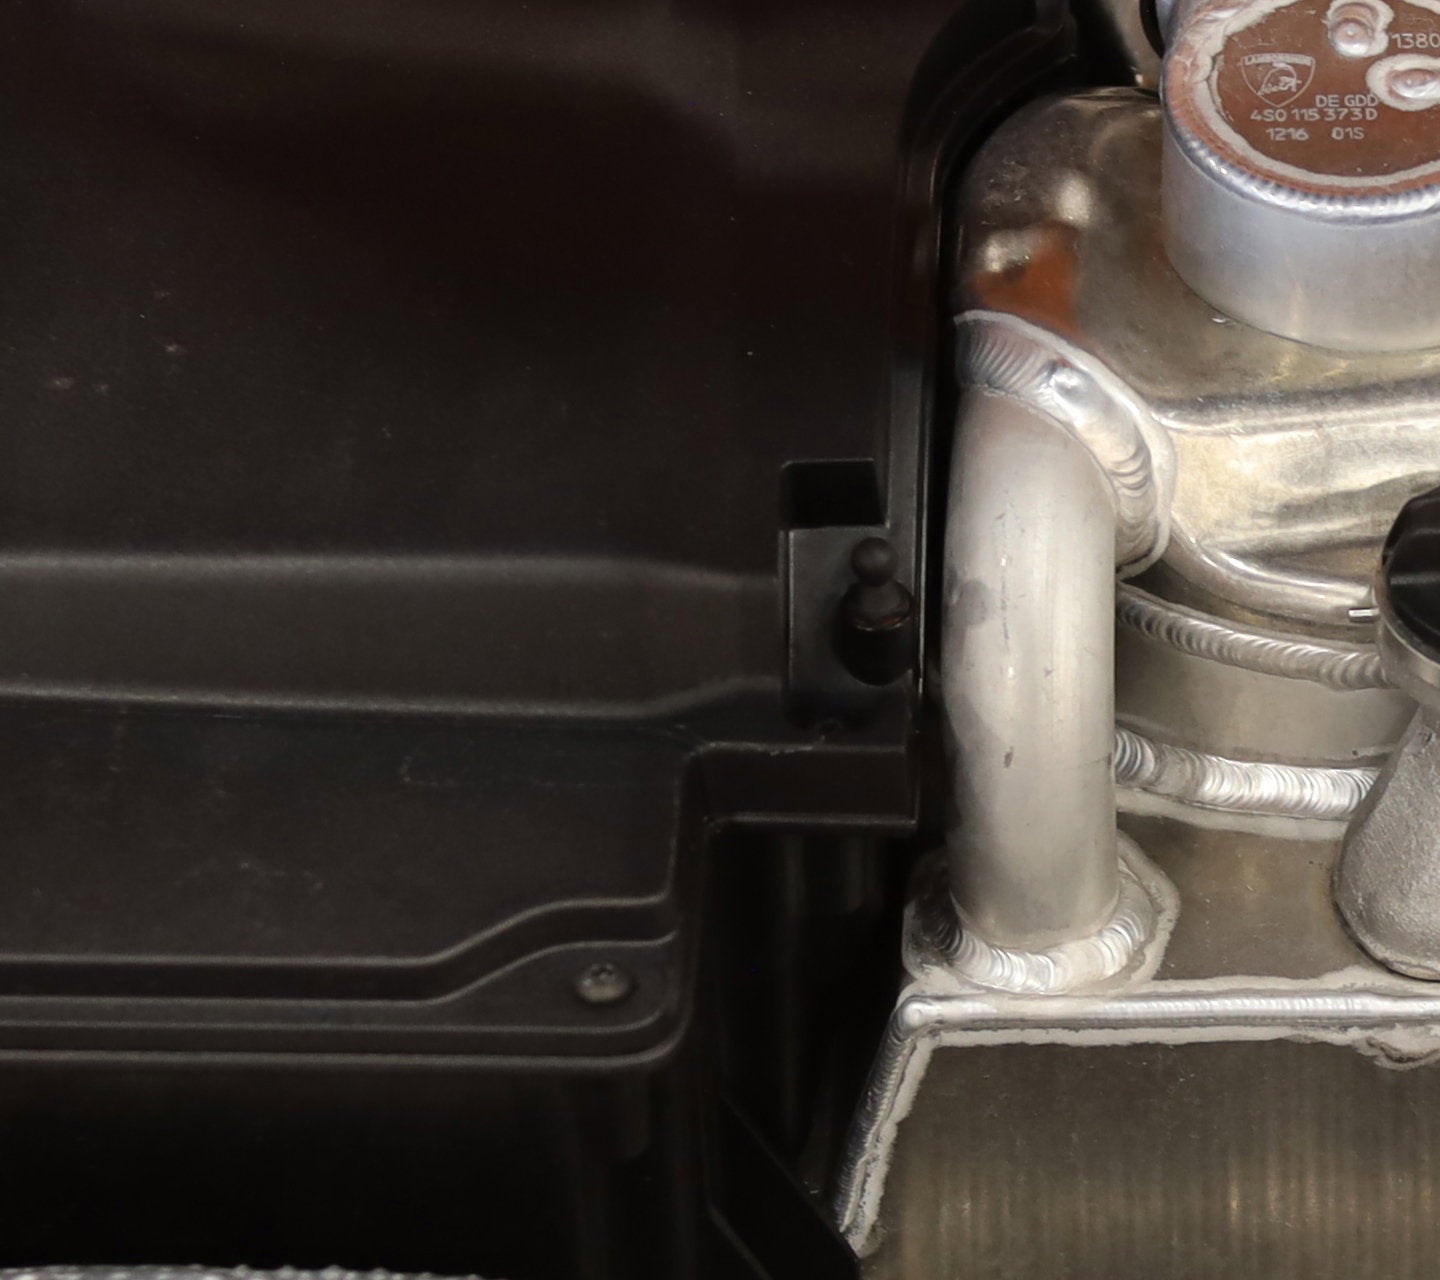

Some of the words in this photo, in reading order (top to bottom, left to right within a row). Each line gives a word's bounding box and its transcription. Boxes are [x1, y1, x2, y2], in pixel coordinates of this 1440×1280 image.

[1315, 94, 1340, 108] DE
[1344, 94, 1379, 108] GDD
[1291, 108, 1320, 121] 115
[1265, 127, 1310, 141] 1216
